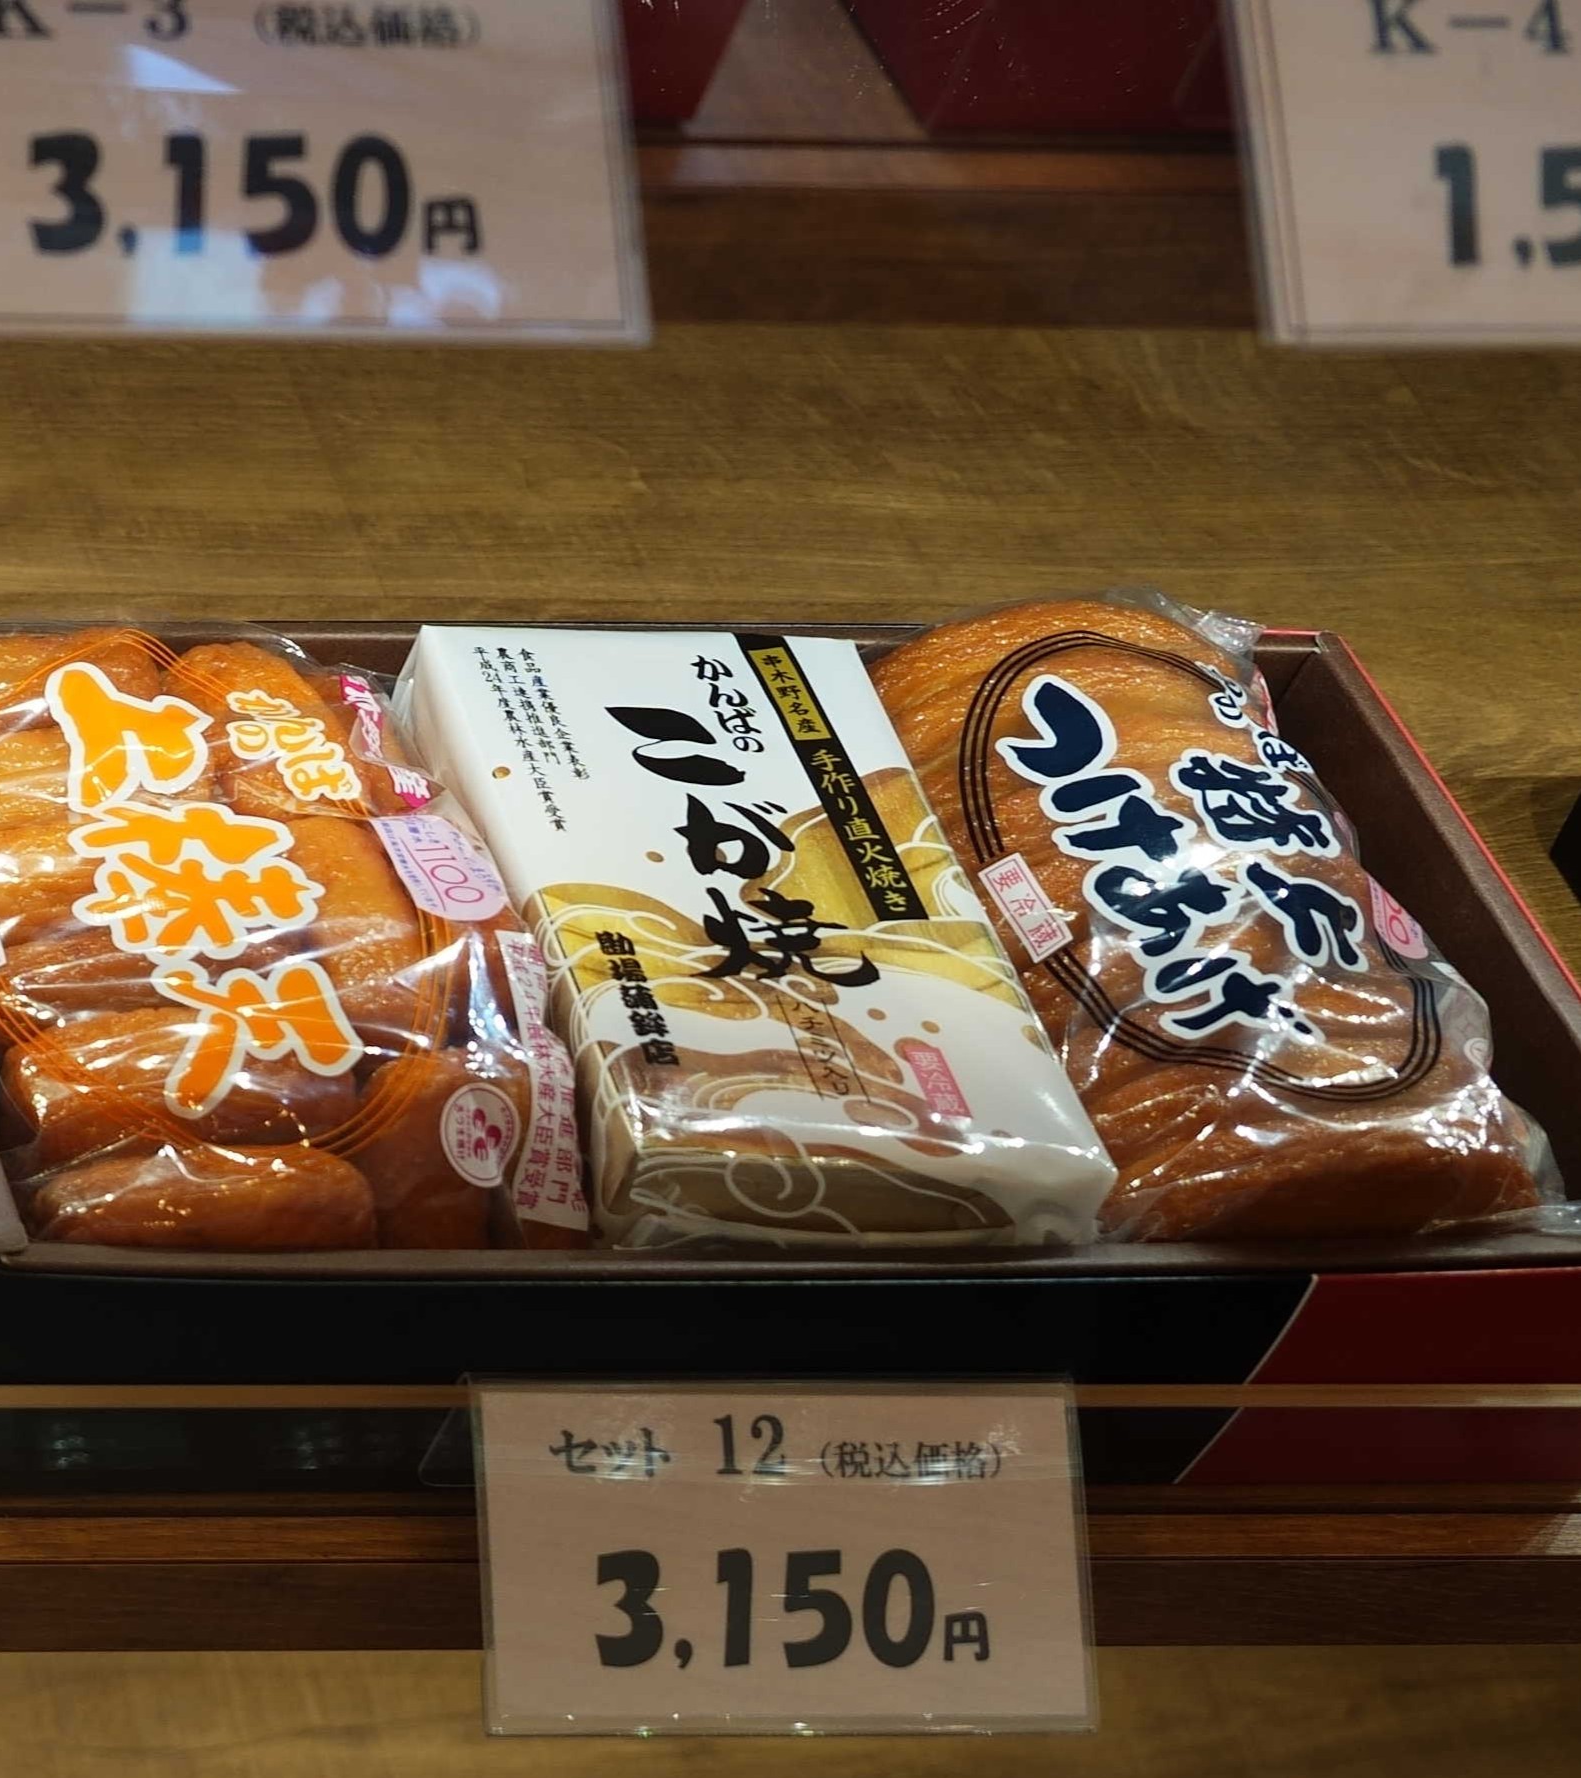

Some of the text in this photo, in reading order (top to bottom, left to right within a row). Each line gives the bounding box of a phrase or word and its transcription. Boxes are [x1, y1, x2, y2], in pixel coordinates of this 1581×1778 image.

[689, 653, 767, 755] かんばの
[760, 653, 823, 737] 串木野名産
[54, 664, 360, 1112] 上棒天
[603, 704, 882, 988] こが焼
[808, 747, 911, 915] 手作り直火焼き
[1003, 680, 1316, 1036] つけあげ
[1174, 752, 1364, 968] 特上
[549, 1413, 1003, 1481] セット 12 (税込価格)
[594, 1548, 991, 1670] 3,150円
